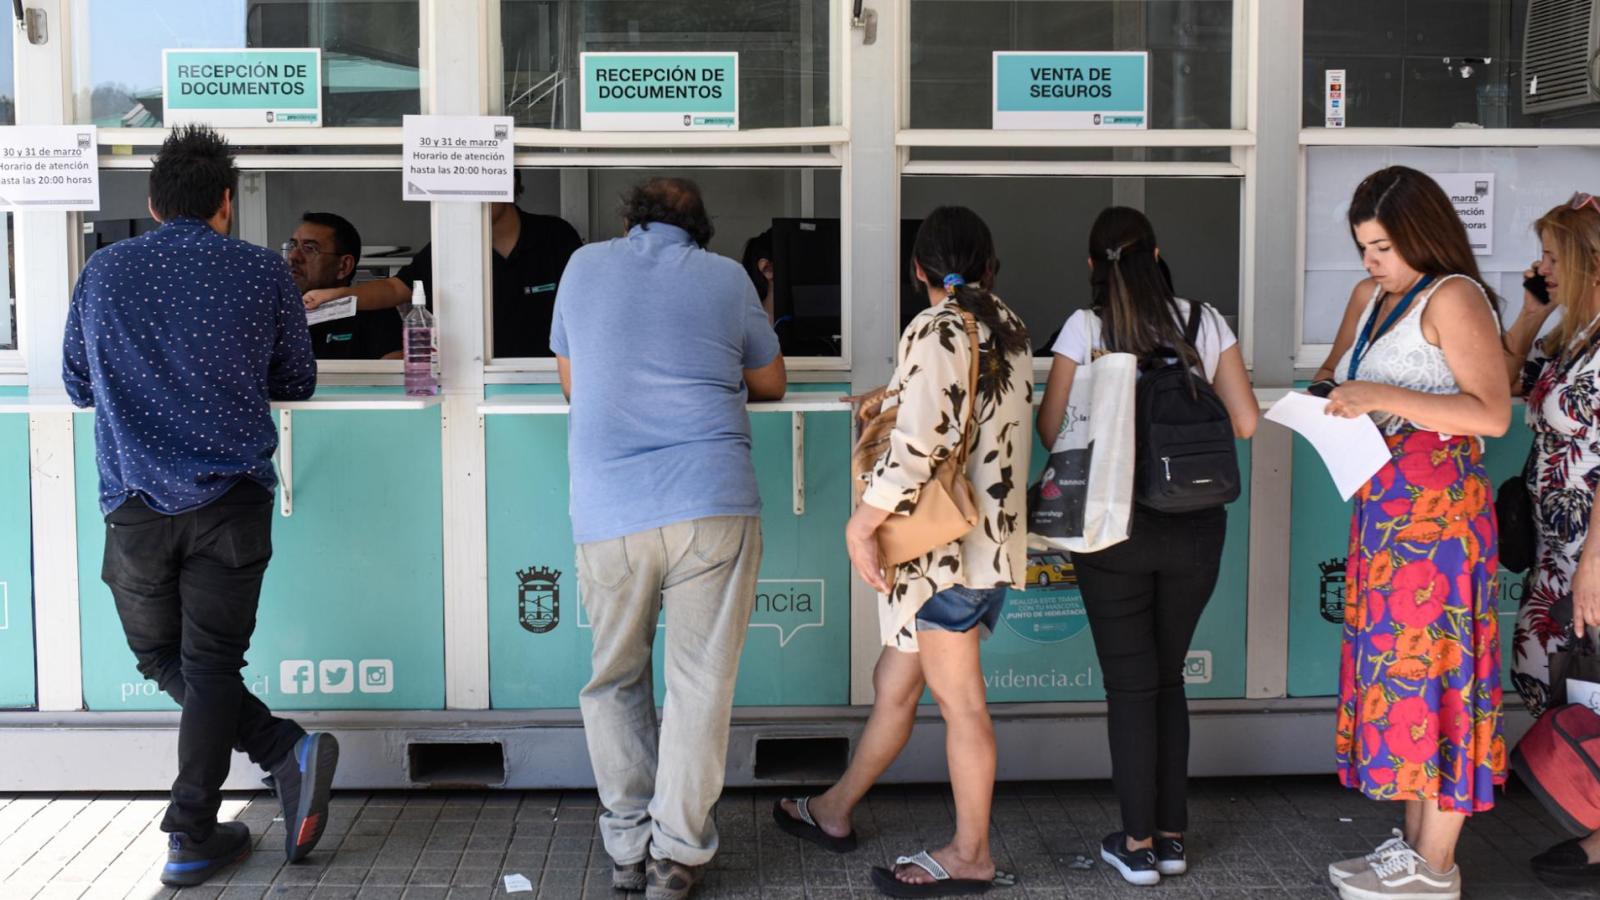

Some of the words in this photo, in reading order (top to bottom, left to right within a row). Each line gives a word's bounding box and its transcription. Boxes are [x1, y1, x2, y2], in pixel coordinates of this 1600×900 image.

[178, 61, 278, 78] RECEPCIÓN
[284, 65, 307, 78] DE
[596, 65, 696, 82] RECEPCIÓN
[701, 68, 724, 82] DE
[1030, 68, 1084, 81] VENTA
[1089, 68, 1112, 81] DE
[181, 81, 305, 95] DOCUMENTOS
[599, 85, 722, 99] DOCUMENTOS
[1030, 85, 1112, 98] SEGUROS
[420, 137, 431, 146] 30
[434, 139, 439, 147] y
[441, 137, 452, 146] 31
[455, 137, 467, 147] de
[469, 139, 498, 147] marzo
[3, 148, 15, 156] 30
[17, 149, 22, 157] y
[25, 147, 36, 156] 31
[39, 147, 51, 156] de
[53, 148, 82, 156] marzo
[413, 152, 448, 160] Horario
[450, 152, 462, 160] de
[465, 152, 505, 161] atención
[35, 162, 47, 170] de
[49, 161, 89, 170] atención
[410, 165, 435, 174] hasta
[438, 165, 451, 174] las
[453, 166, 479, 175] 20:00
[481, 166, 508, 175] horas
[1, 177, 20, 185] asta
[23, 176, 36, 185] las
[38, 176, 64, 184] 20:00
[66, 176, 93, 184] horas
[1044, 608, 1087, 617] HIDRATACIÓ
[982, 667, 1092, 689] videncia.cl
